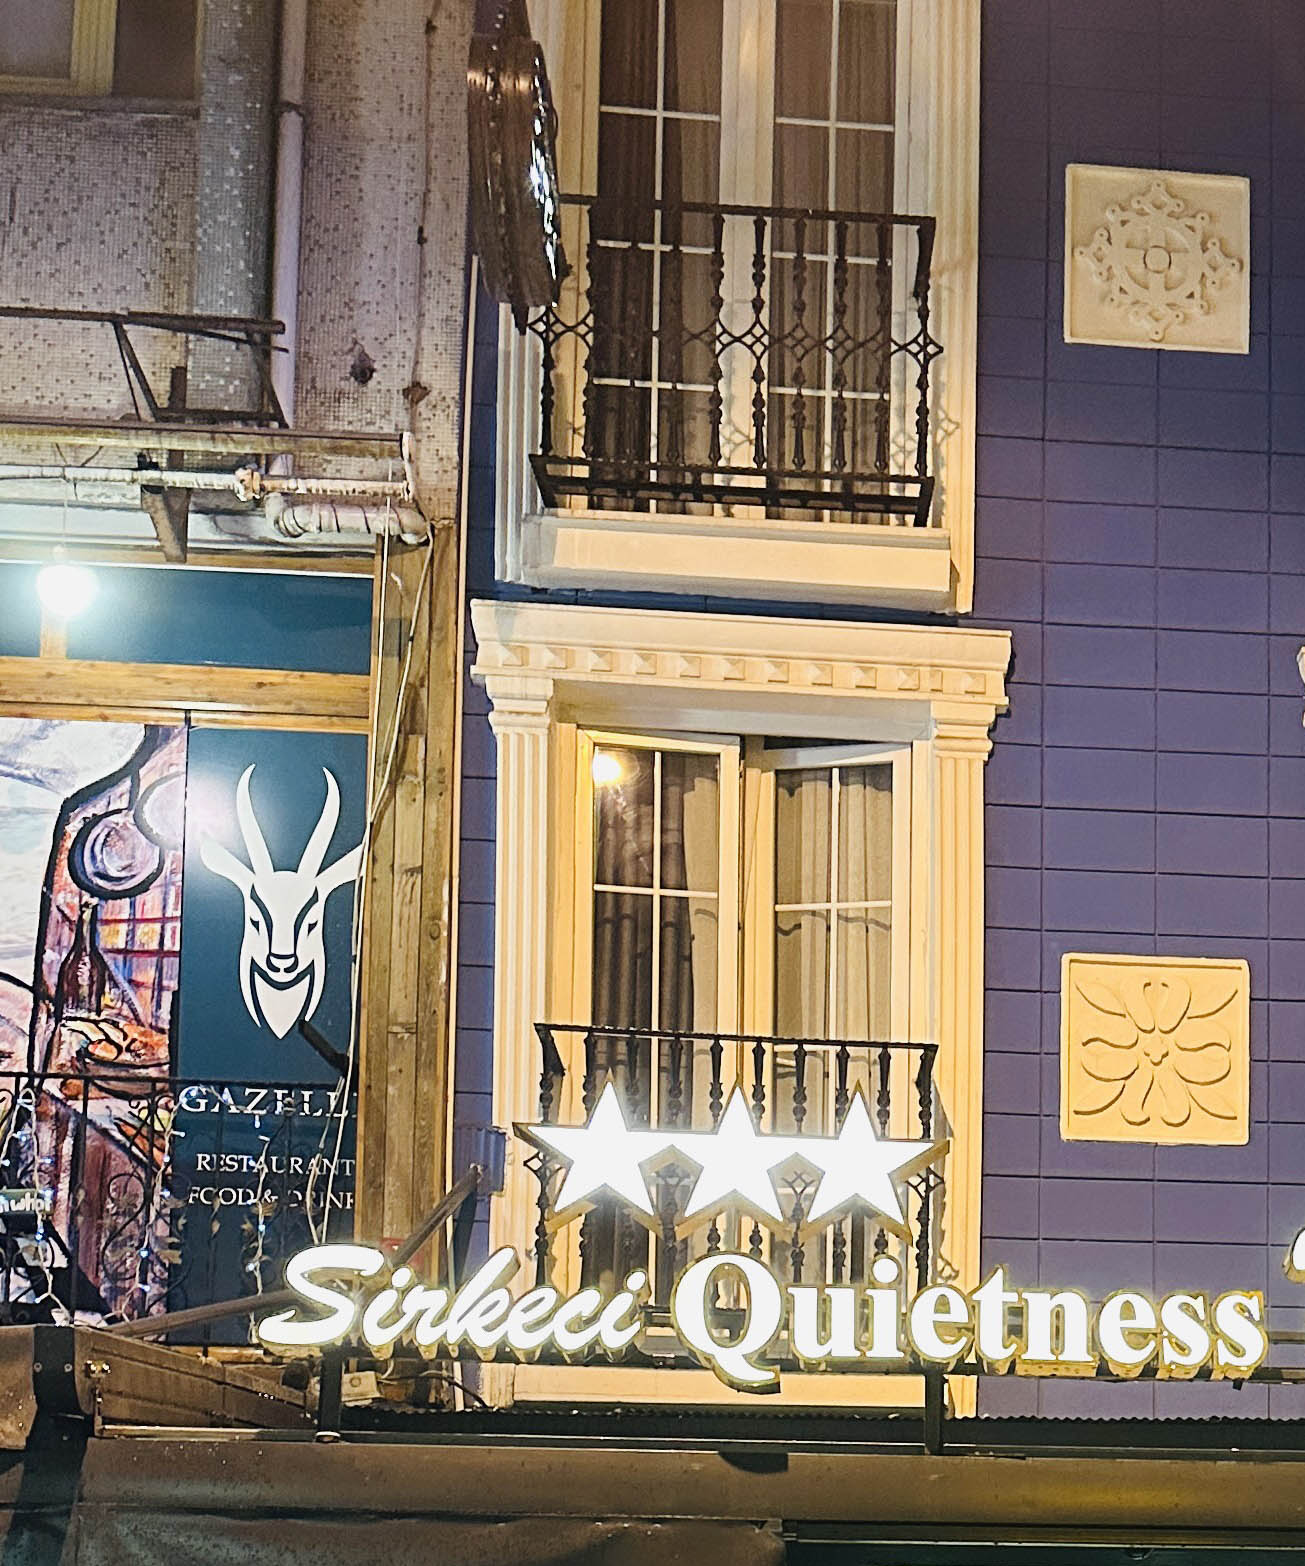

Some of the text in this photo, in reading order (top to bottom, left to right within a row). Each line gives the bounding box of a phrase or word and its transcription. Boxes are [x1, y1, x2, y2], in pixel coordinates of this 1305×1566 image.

[179, 1085, 357, 1118] GAZELL
[257, 1244, 646, 1352] Sirkeci
[674, 1252, 1267, 1385] Quietness
